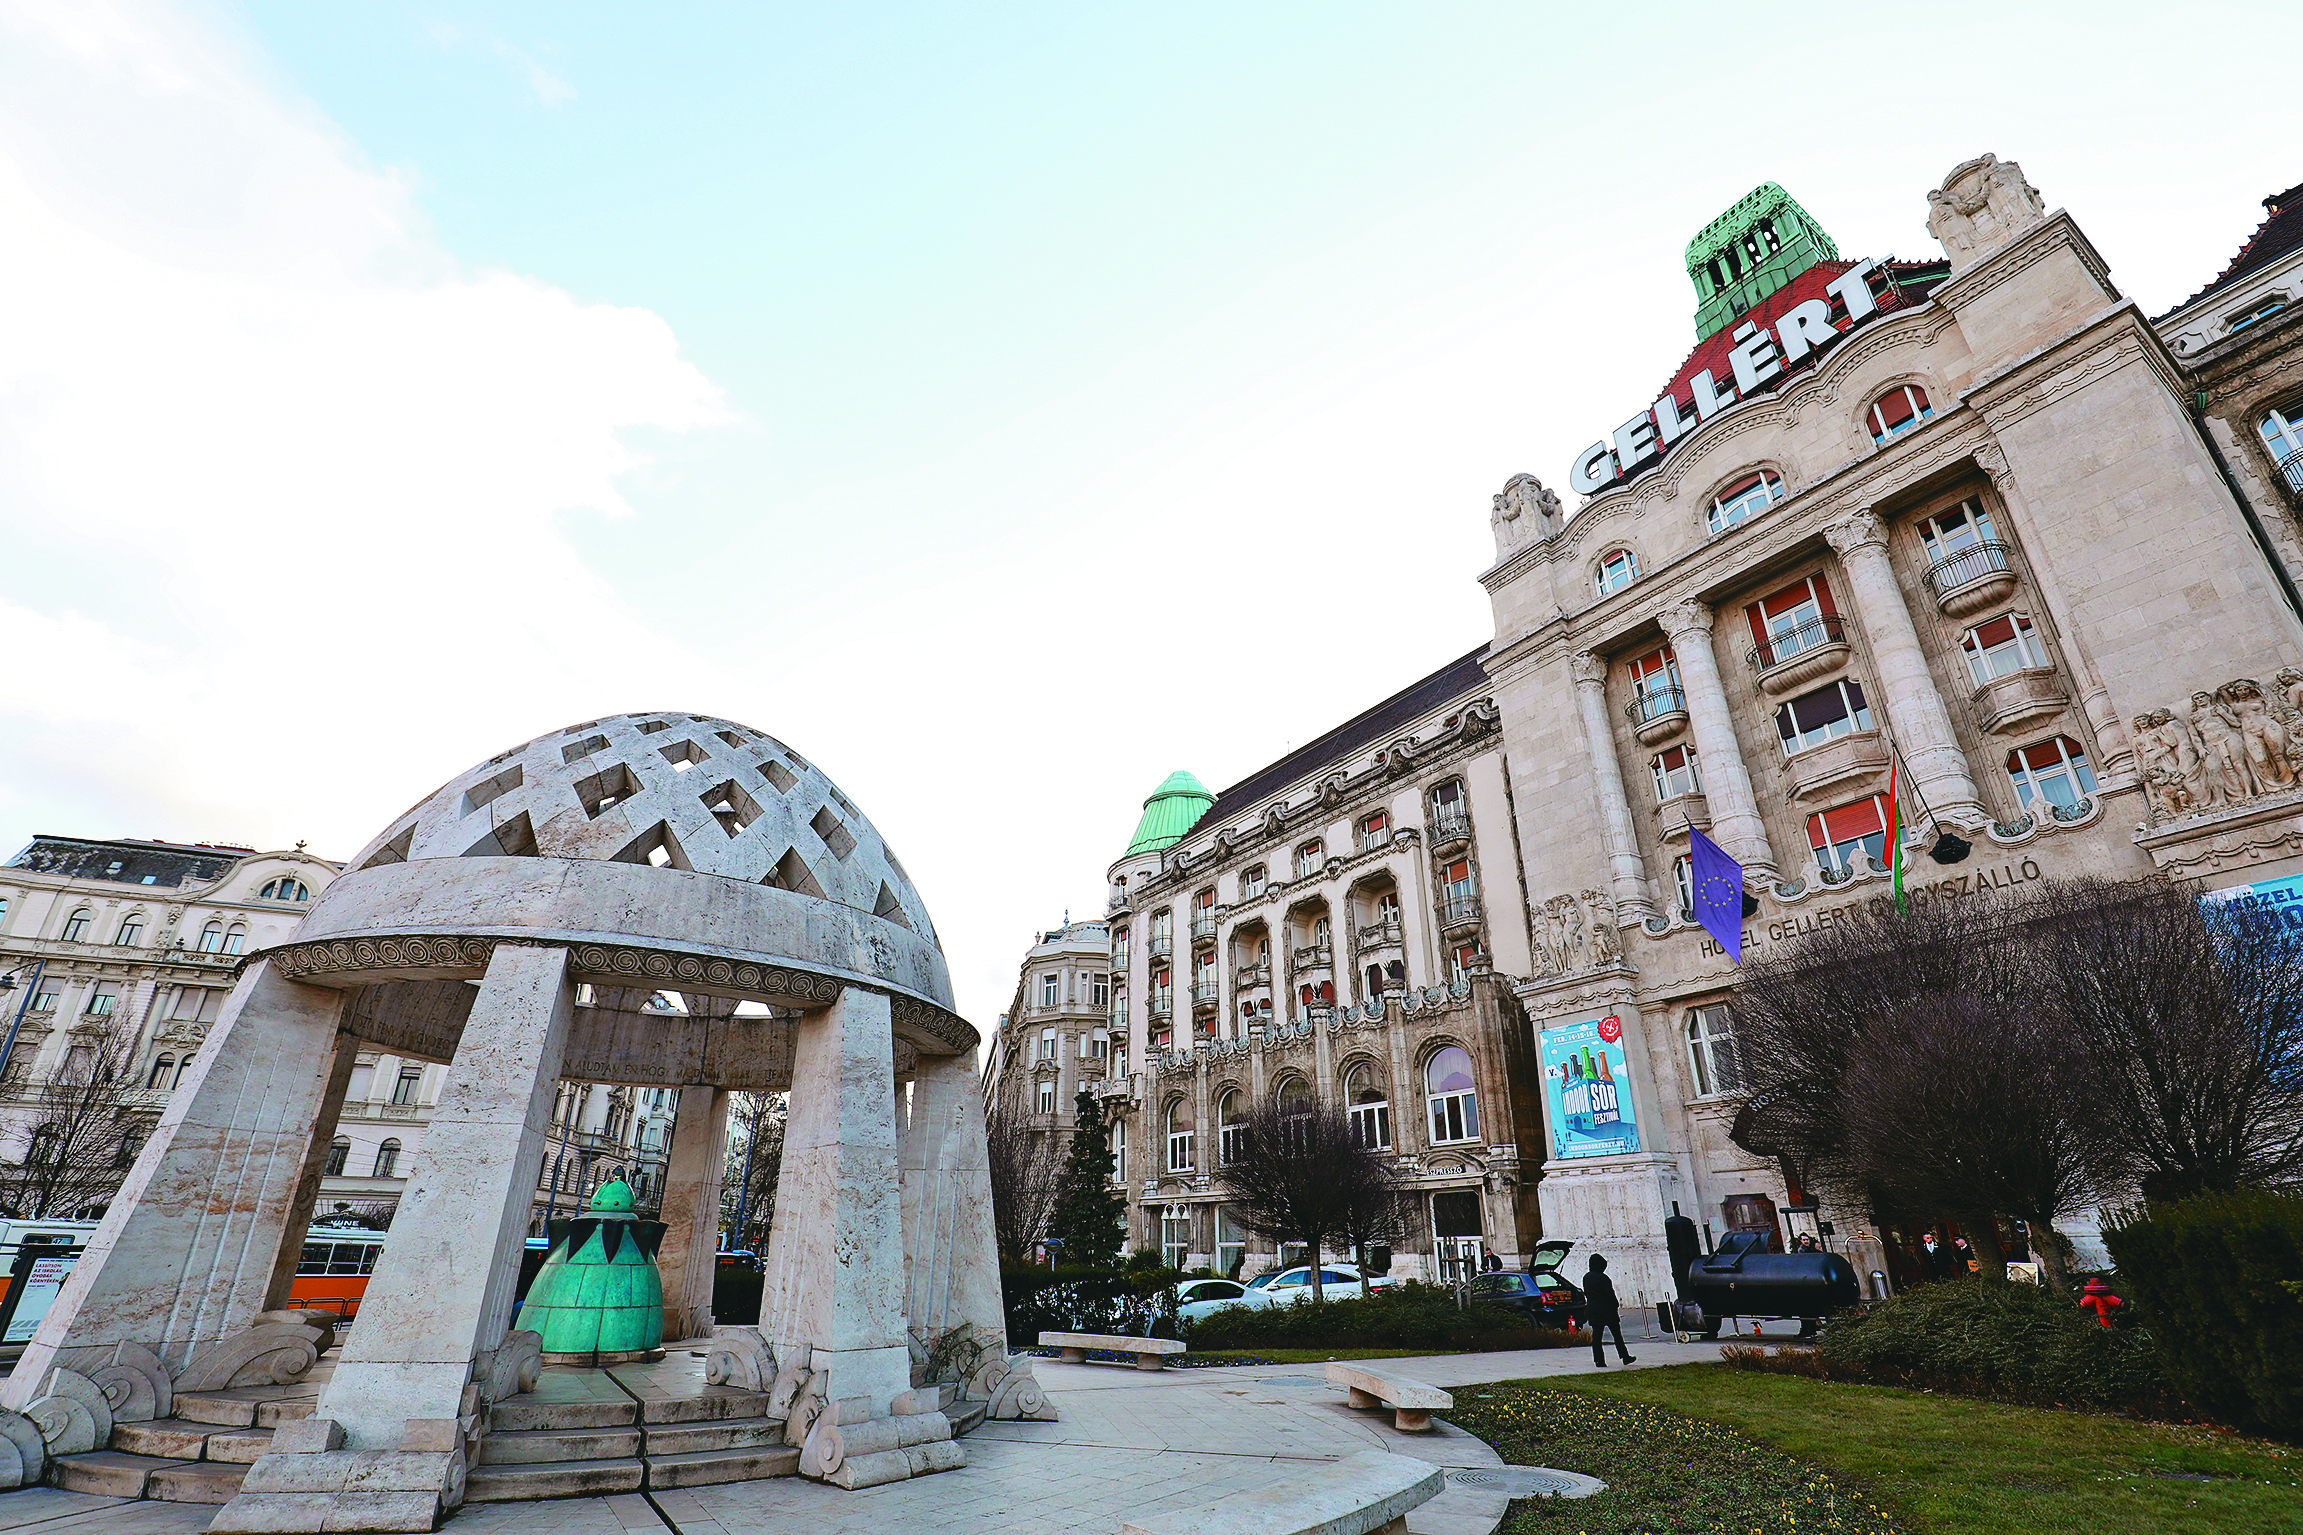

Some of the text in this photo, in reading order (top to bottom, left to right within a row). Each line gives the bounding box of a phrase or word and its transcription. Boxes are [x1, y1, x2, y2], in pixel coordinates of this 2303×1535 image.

[1570, 253, 1895, 495] GELLÉRT
[1700, 928, 1761, 958] HOEL
[1768, 904, 1857, 941] GELLÉRT
[1562, 1083, 1590, 1115] INDOOR
[1589, 1081, 1618, 1111] SÖR
[1593, 1110, 1620, 1125] FESZTIVÁL
